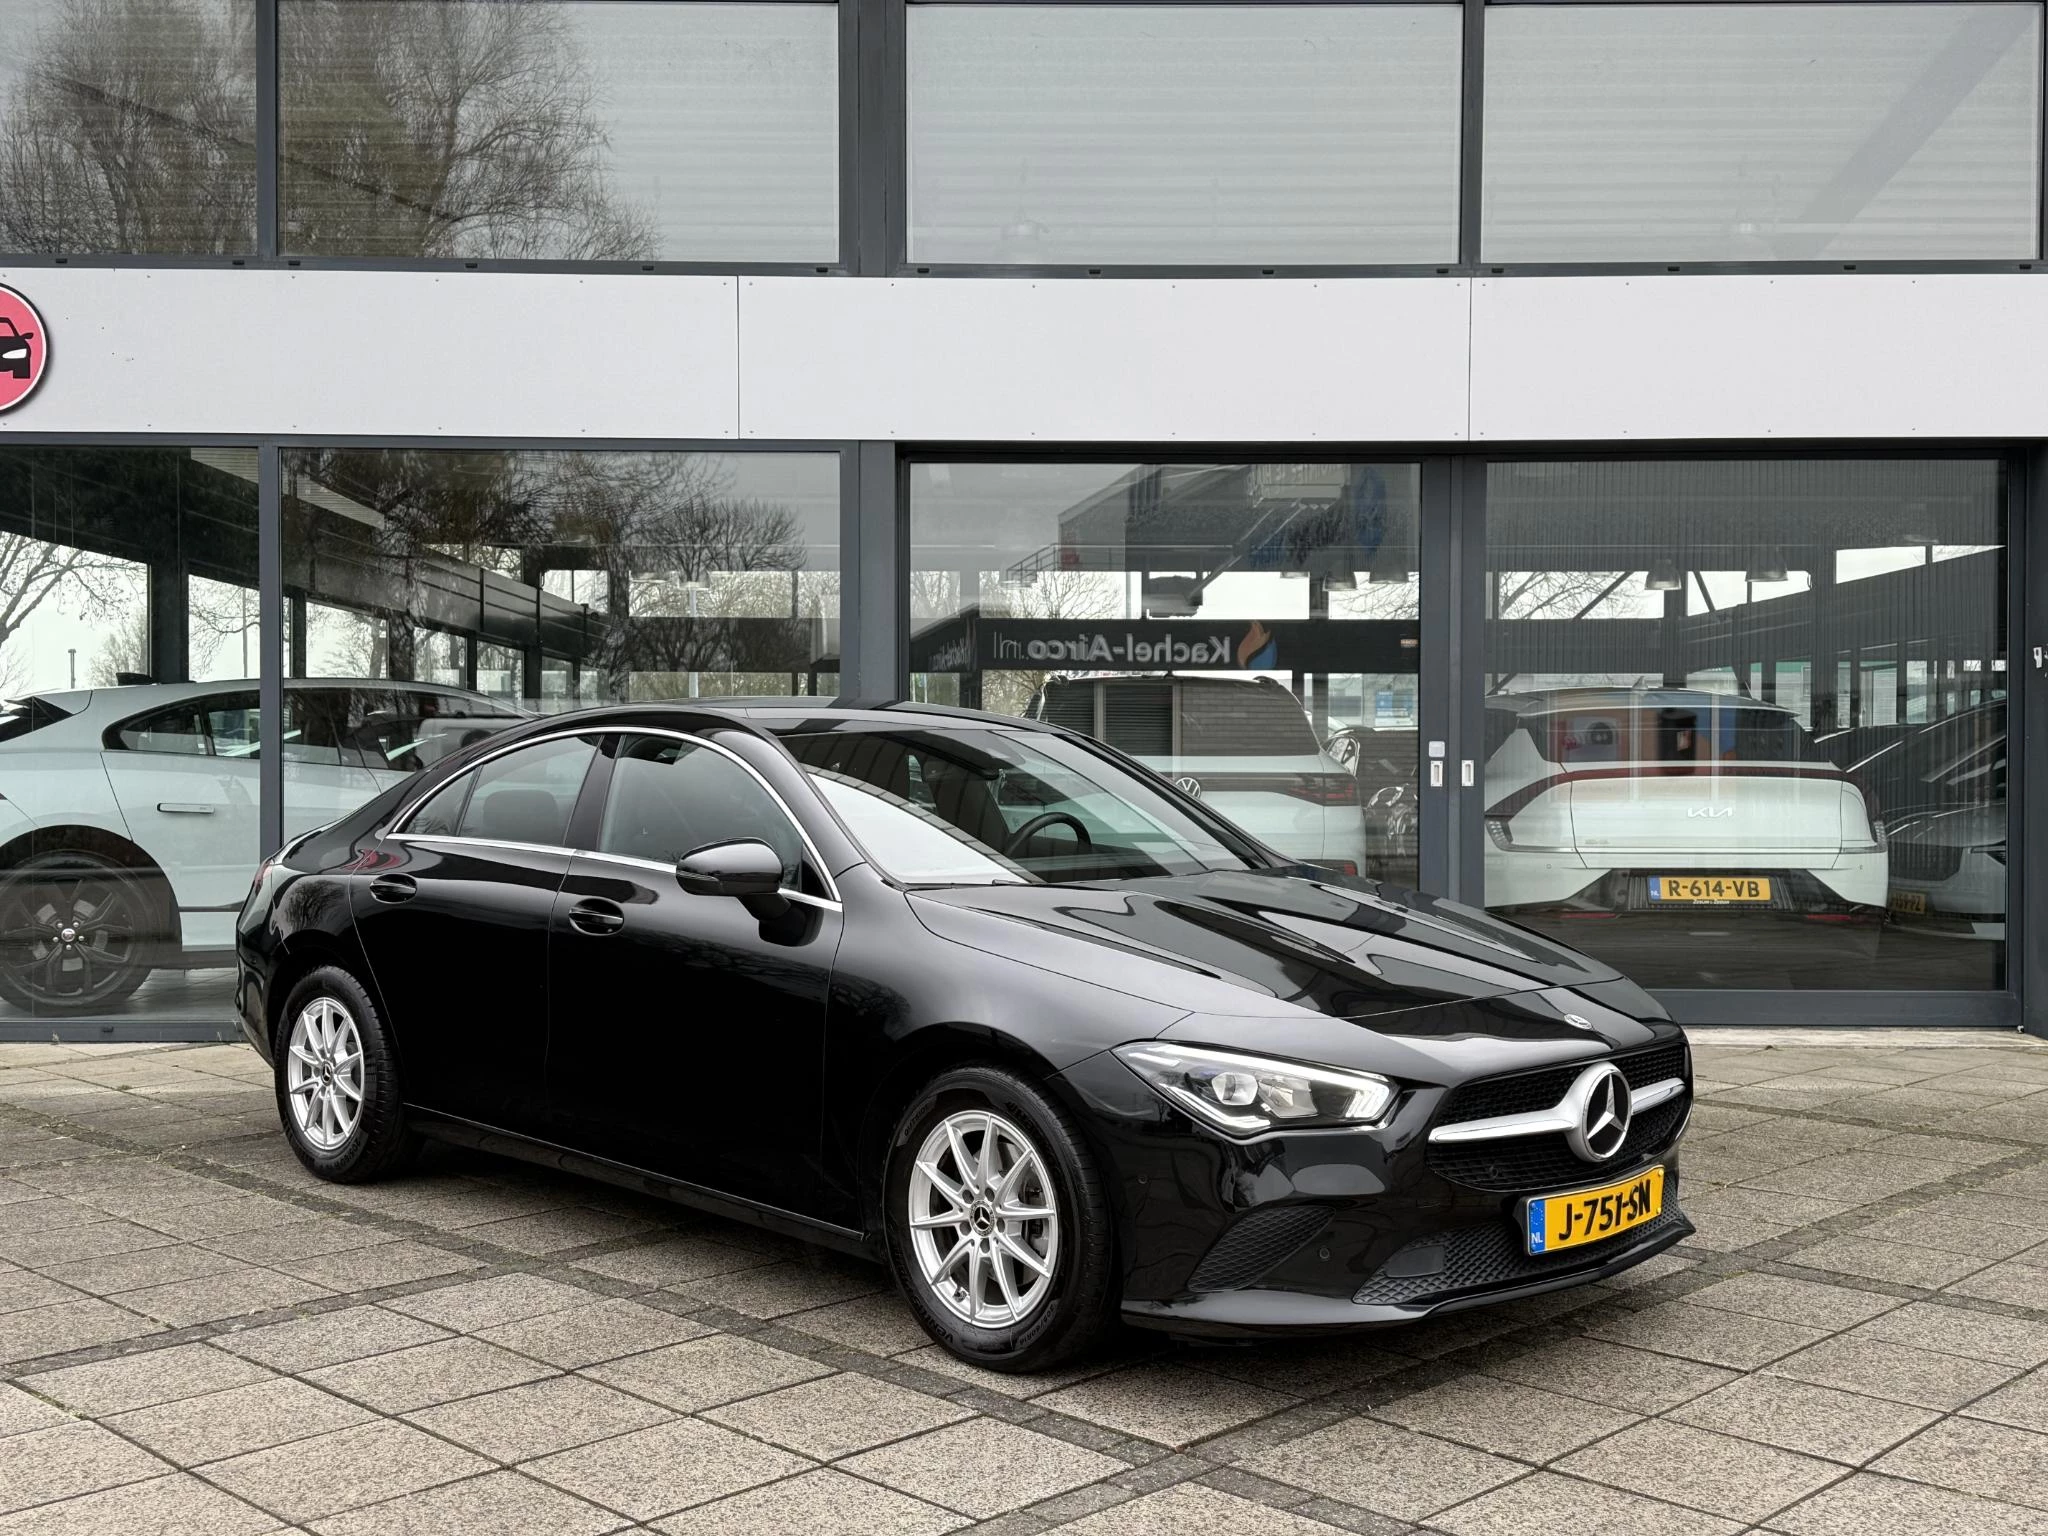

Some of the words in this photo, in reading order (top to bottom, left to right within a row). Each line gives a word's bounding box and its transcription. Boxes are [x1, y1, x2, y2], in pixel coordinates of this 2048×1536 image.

[1687, 807, 1733, 817] KIA
[1668, 880, 1760, 897] R-614-VB
[1531, 1232, 1543, 1244] NL
[1558, 1178, 1651, 1242] J-751-SN
